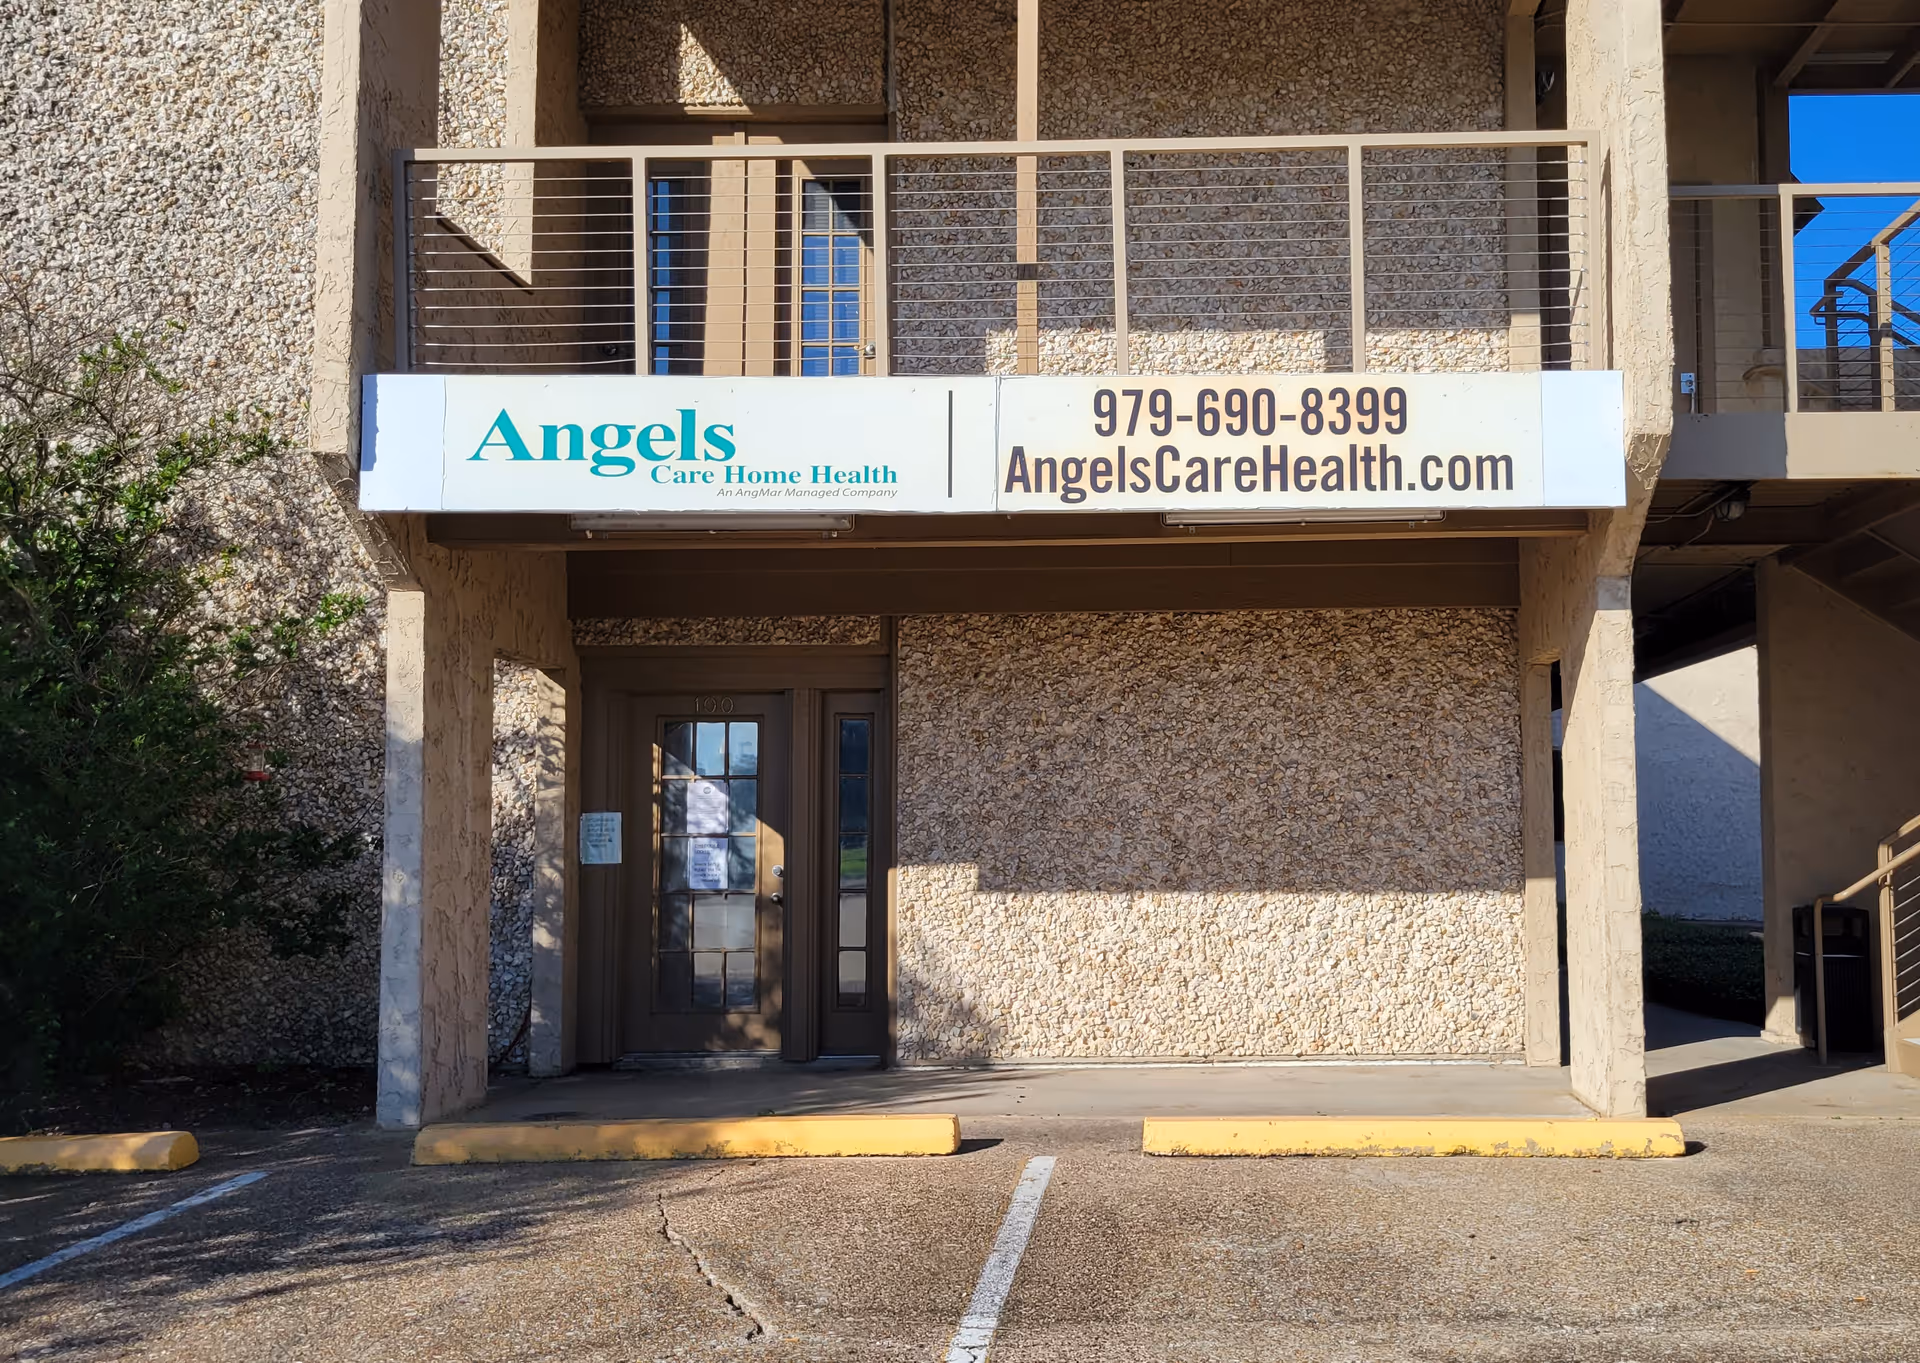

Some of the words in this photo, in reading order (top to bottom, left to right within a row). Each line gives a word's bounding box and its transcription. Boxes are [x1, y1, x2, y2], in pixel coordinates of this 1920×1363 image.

[1093, 387, 1407, 437] 979-690-8399
[466, 408, 736, 478] Angels
[650, 465, 715, 484] Care
[723, 465, 801, 484] Home
[810, 465, 898, 484] Health
[1004, 443, 1514, 503] AngelsCareHealth.com
[716, 488, 733, 497] An
[735, 488, 782, 498] AngMar
[784, 488, 840, 498] Managed
[842, 488, 898, 499] Company
[694, 696, 734, 713] 100
